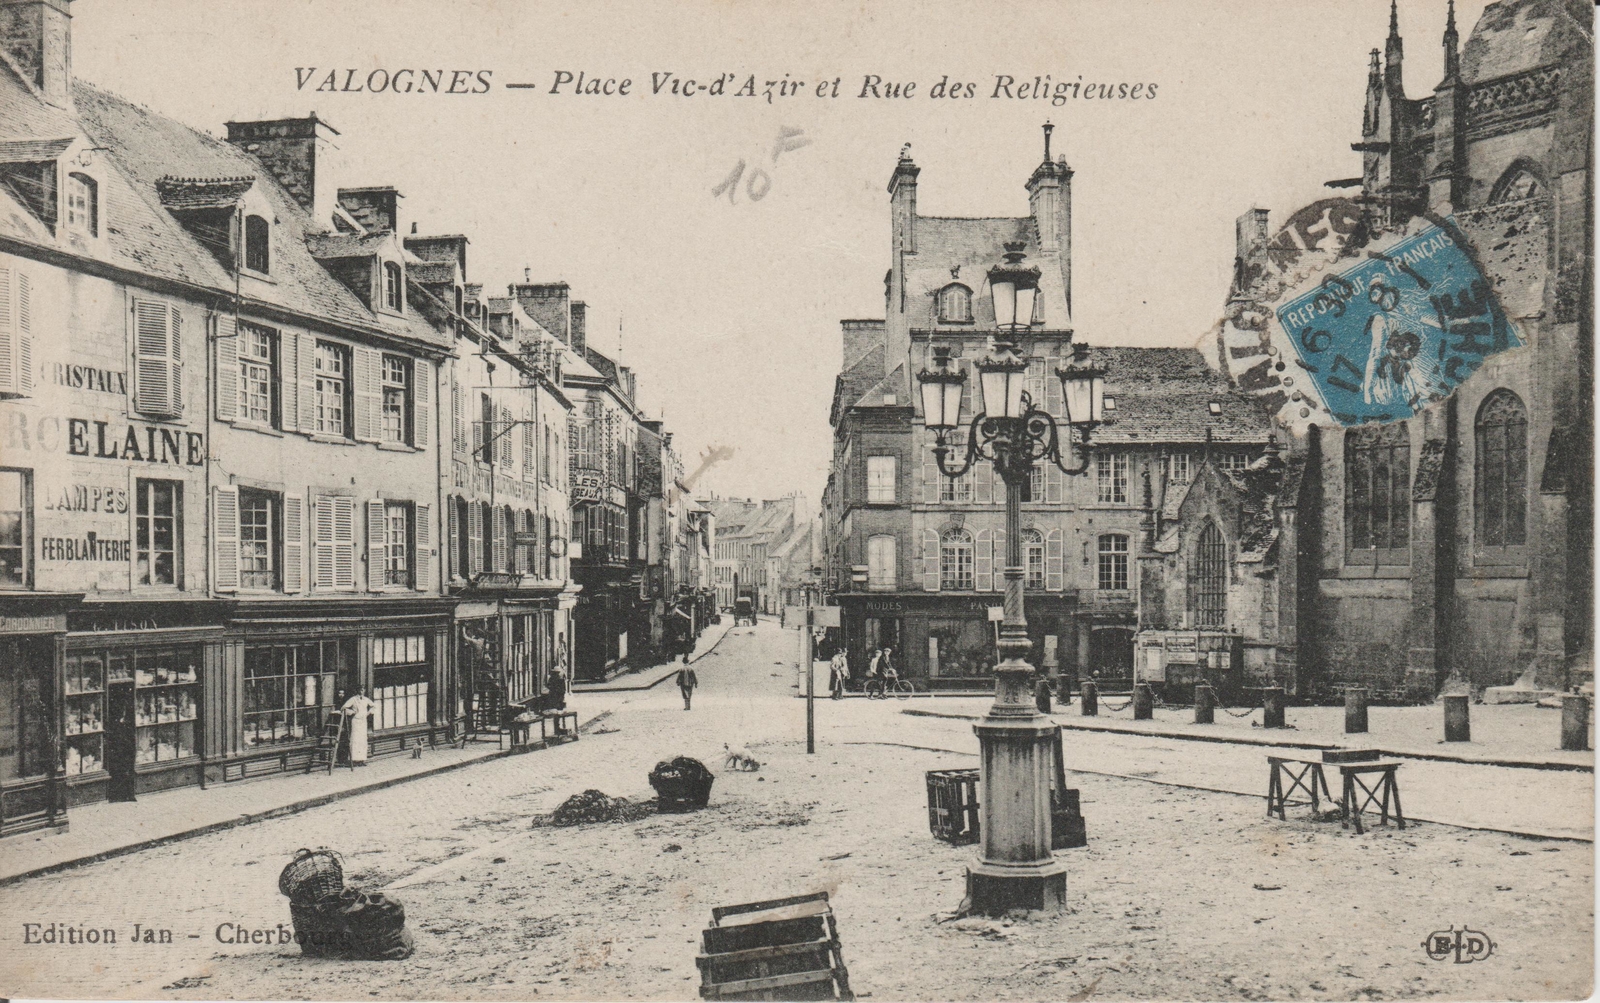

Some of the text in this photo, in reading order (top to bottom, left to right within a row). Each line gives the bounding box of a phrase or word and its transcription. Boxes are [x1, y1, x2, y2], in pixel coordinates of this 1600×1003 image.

[40, 361, 127, 395] CRISTAUX
[45, 484, 128, 514] LAMPES
[42, 535, 130, 562] FERBLANTERIE
[866, 602, 902, 610] MODES
